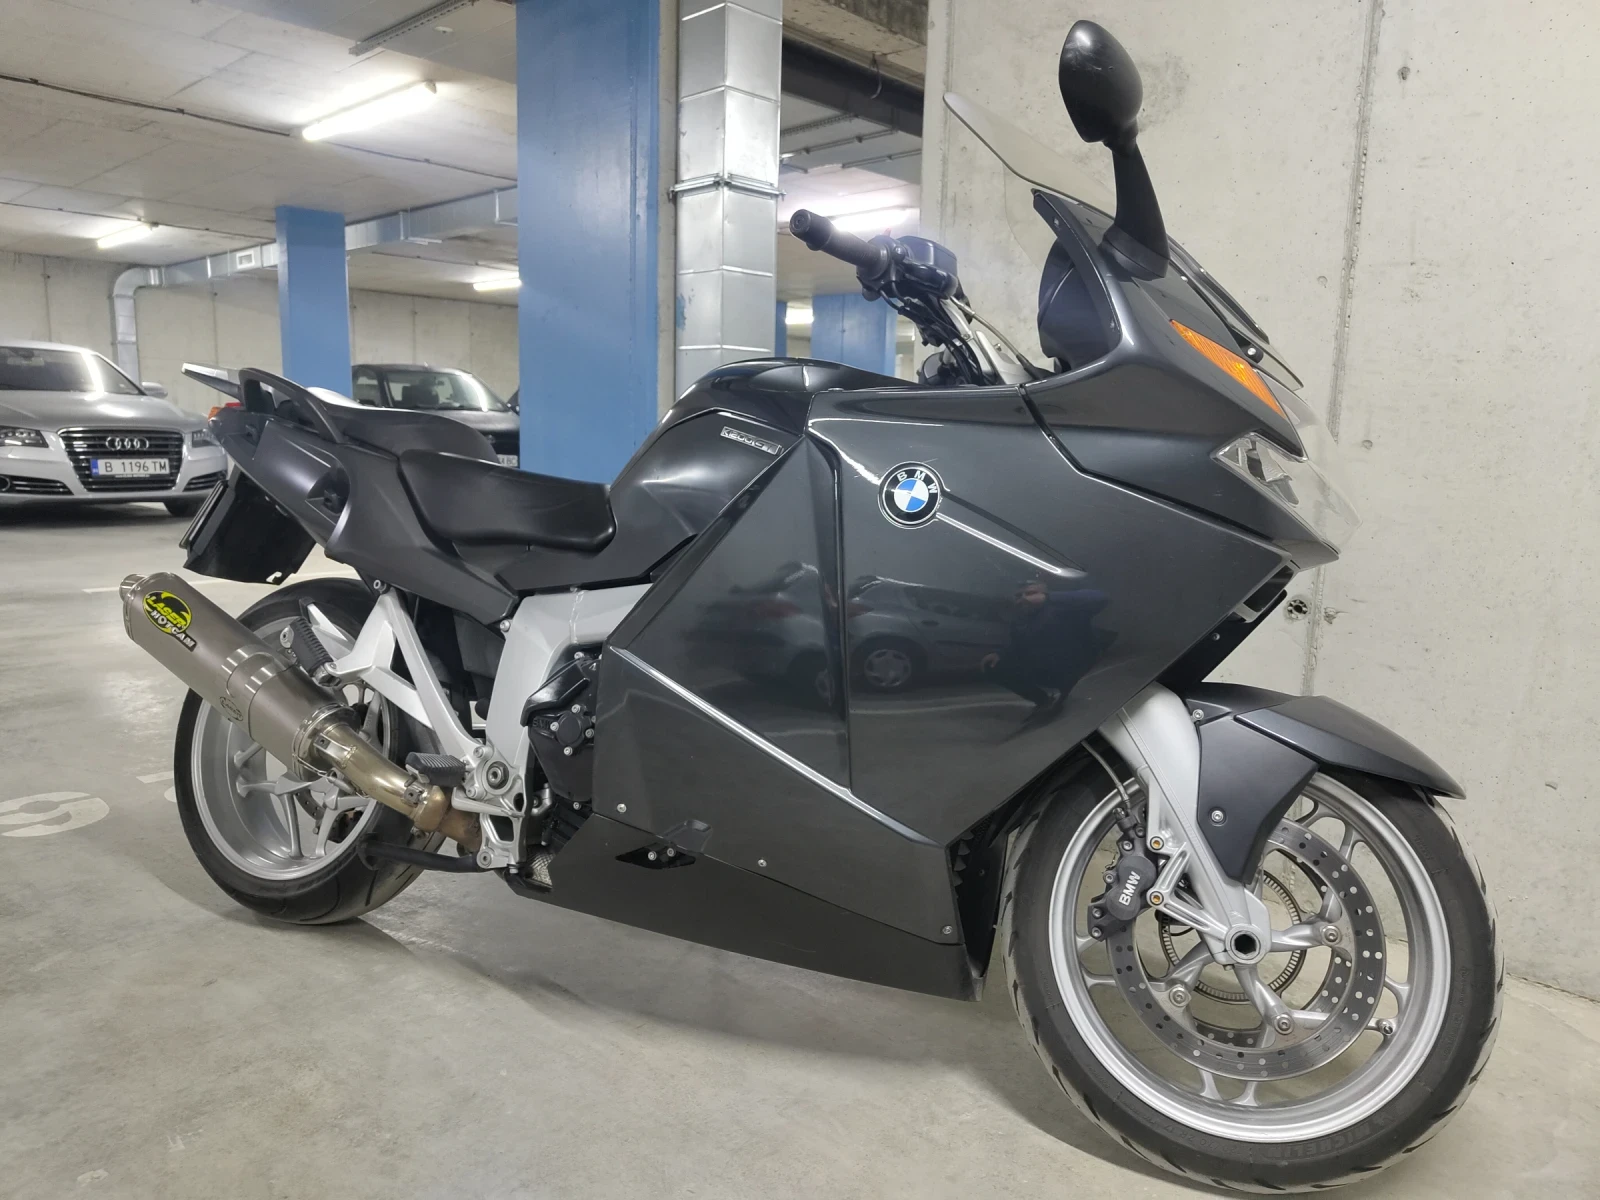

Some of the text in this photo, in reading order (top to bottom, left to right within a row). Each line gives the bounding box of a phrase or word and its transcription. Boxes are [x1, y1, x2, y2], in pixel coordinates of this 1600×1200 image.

[104, 461, 113, 473] B
[121, 461, 149, 472] 1196
[151, 461, 167, 472] TM
[896, 469, 938, 494] BMW
[146, 595, 187, 628] LASER
[150, 610, 196, 648] HOTCAM
[1118, 870, 1141, 906] BMW
